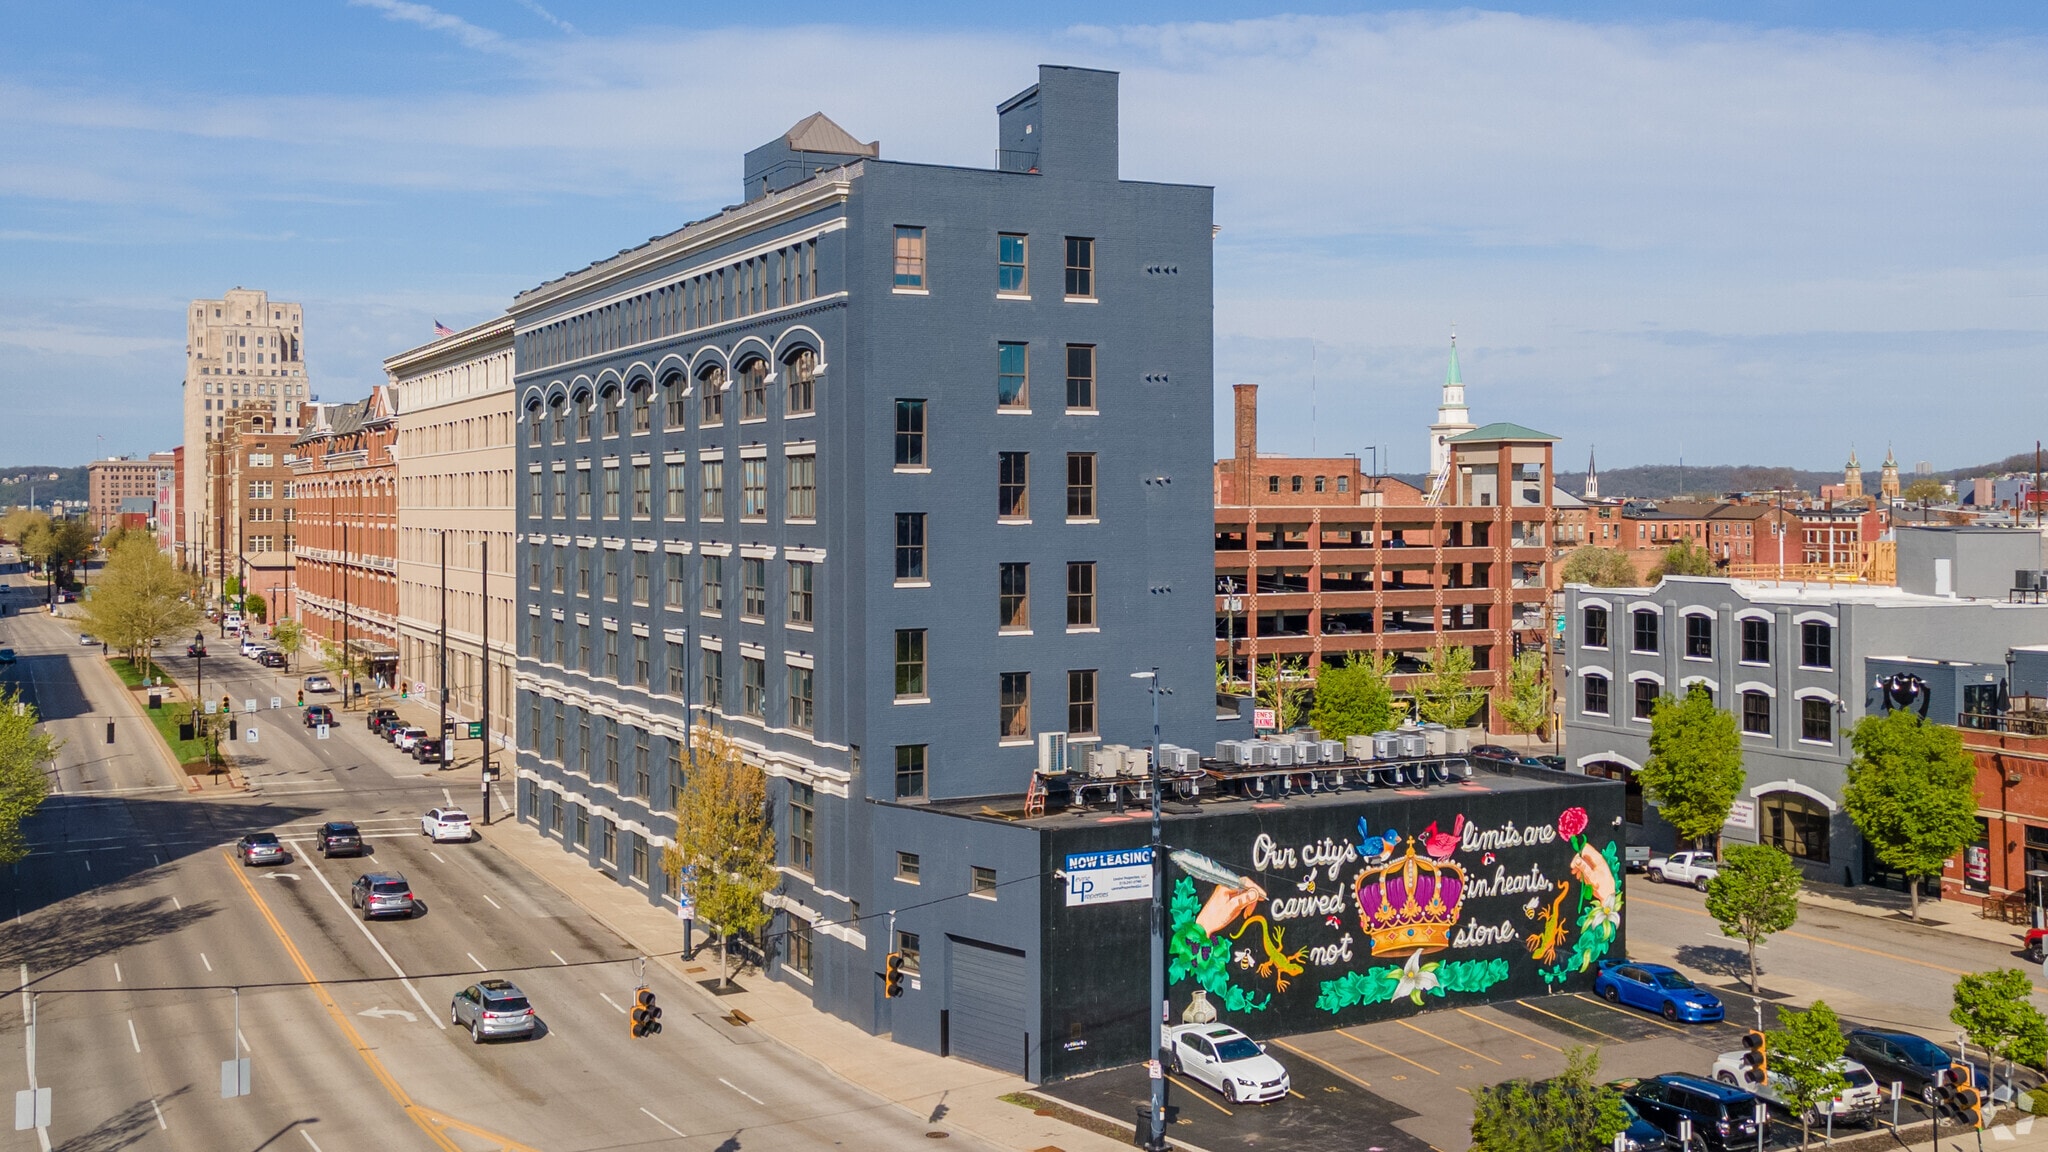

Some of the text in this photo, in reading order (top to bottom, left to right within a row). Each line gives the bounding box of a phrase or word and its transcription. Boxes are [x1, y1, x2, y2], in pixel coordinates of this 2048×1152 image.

[1069, 850, 1150, 869] NOW LEASING
[1253, 820, 1557, 881] Our city's limits are
[1271, 864, 1553, 921] carved in hearts,
[1310, 917, 1519, 965] not stone.
